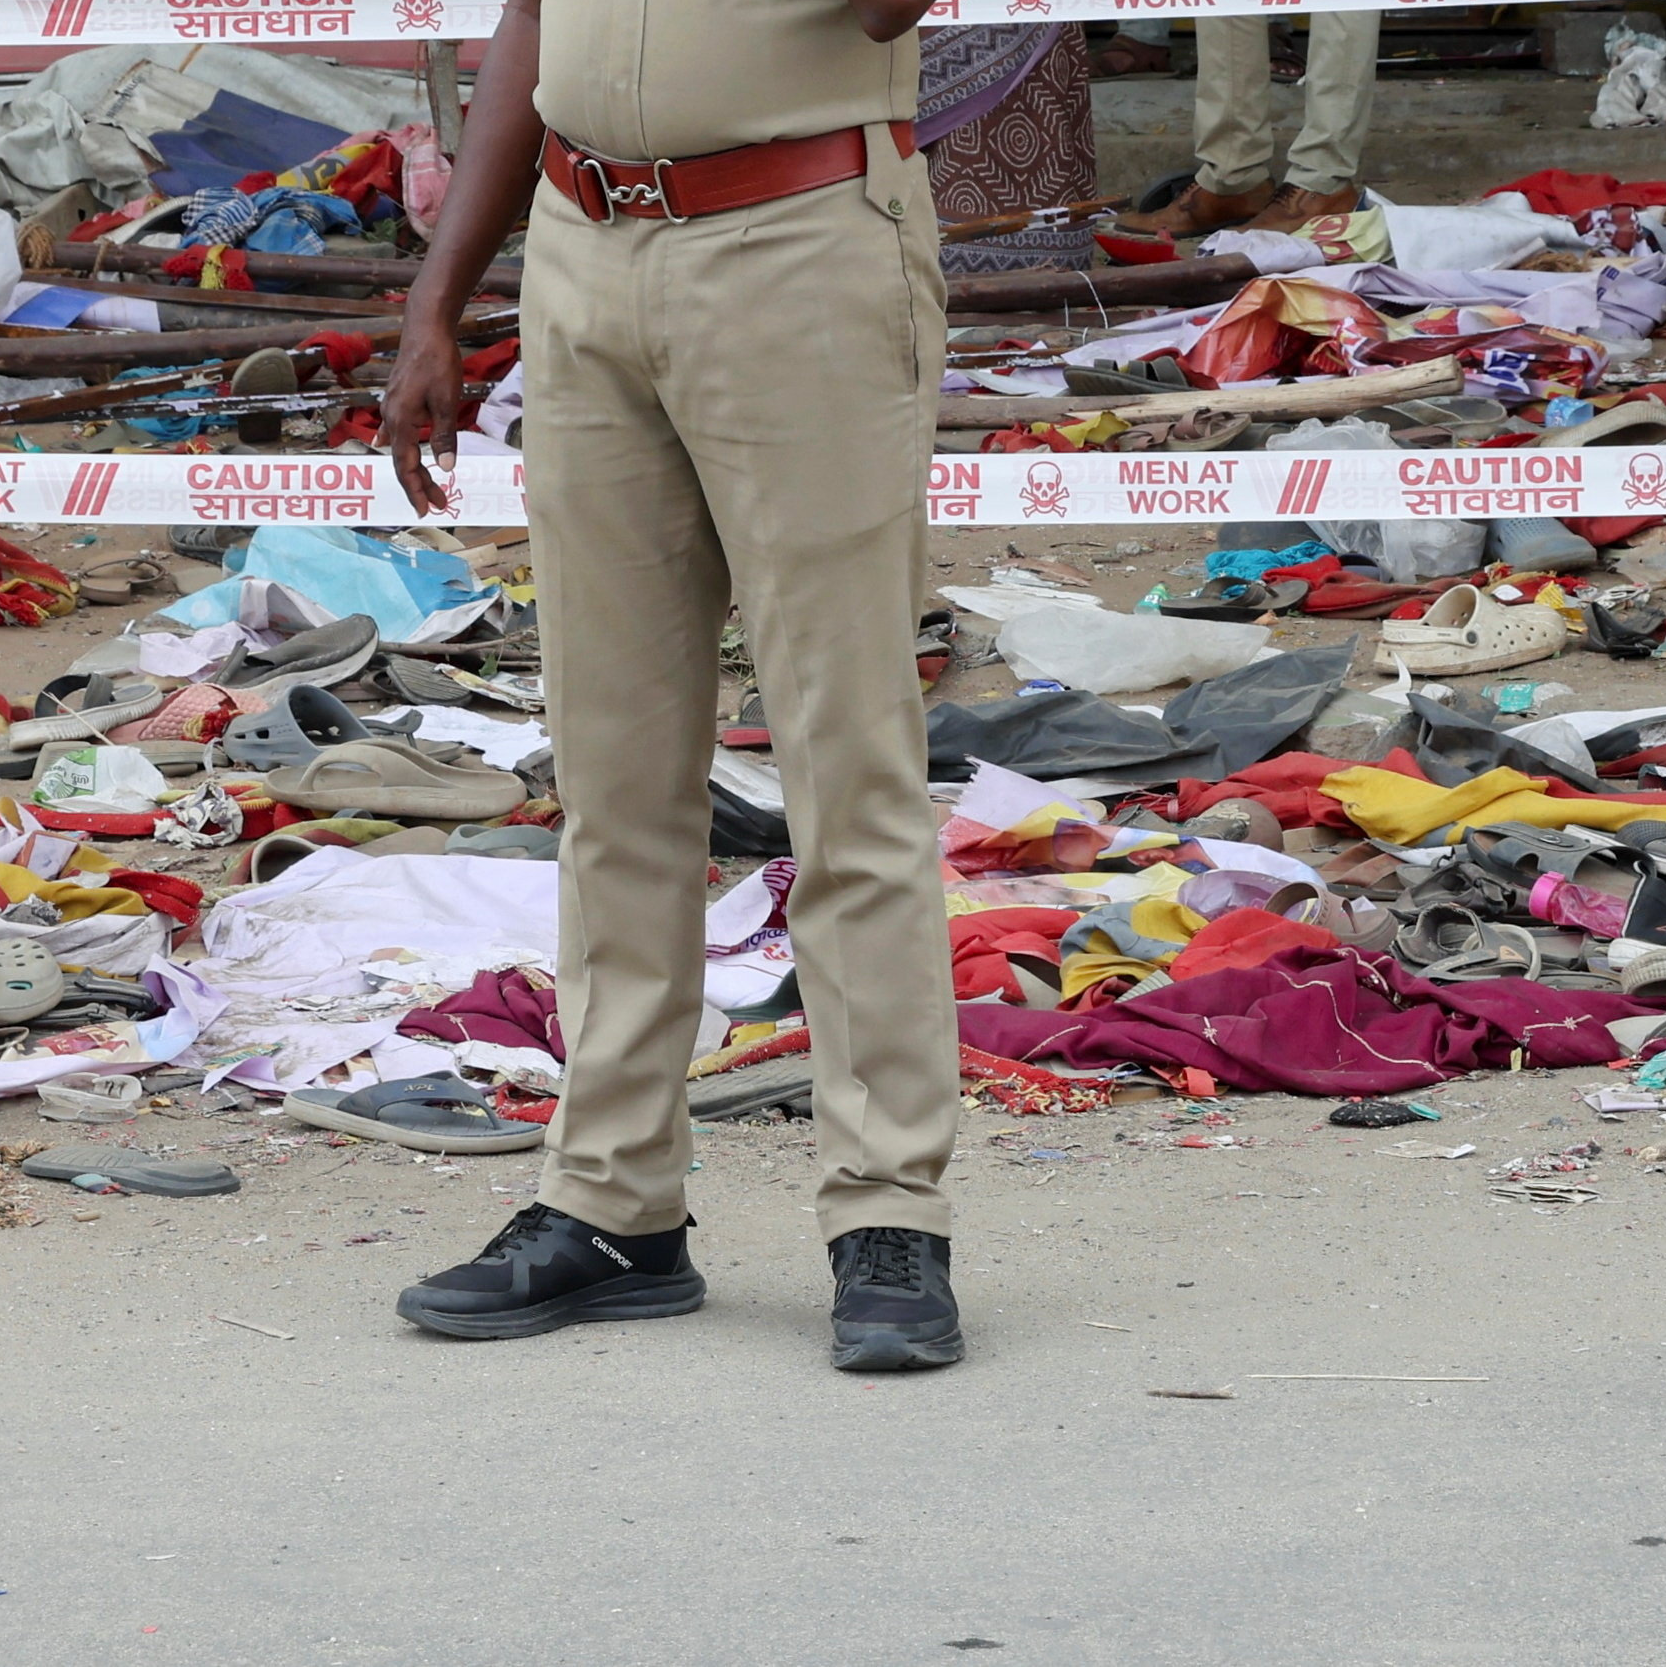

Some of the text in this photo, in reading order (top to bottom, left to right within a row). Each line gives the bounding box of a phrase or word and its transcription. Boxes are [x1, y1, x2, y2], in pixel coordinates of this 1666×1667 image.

[170, 9, 355, 38] सावधान
[187, 463, 373, 491] CAUTION
[1119, 460, 1238, 485] MEN AT
[1399, 455, 1582, 485] CAUTION
[189, 494, 375, 520] सावधान
[1127, 489, 1231, 514] WORK
[1402, 487, 1584, 516] सावधान
